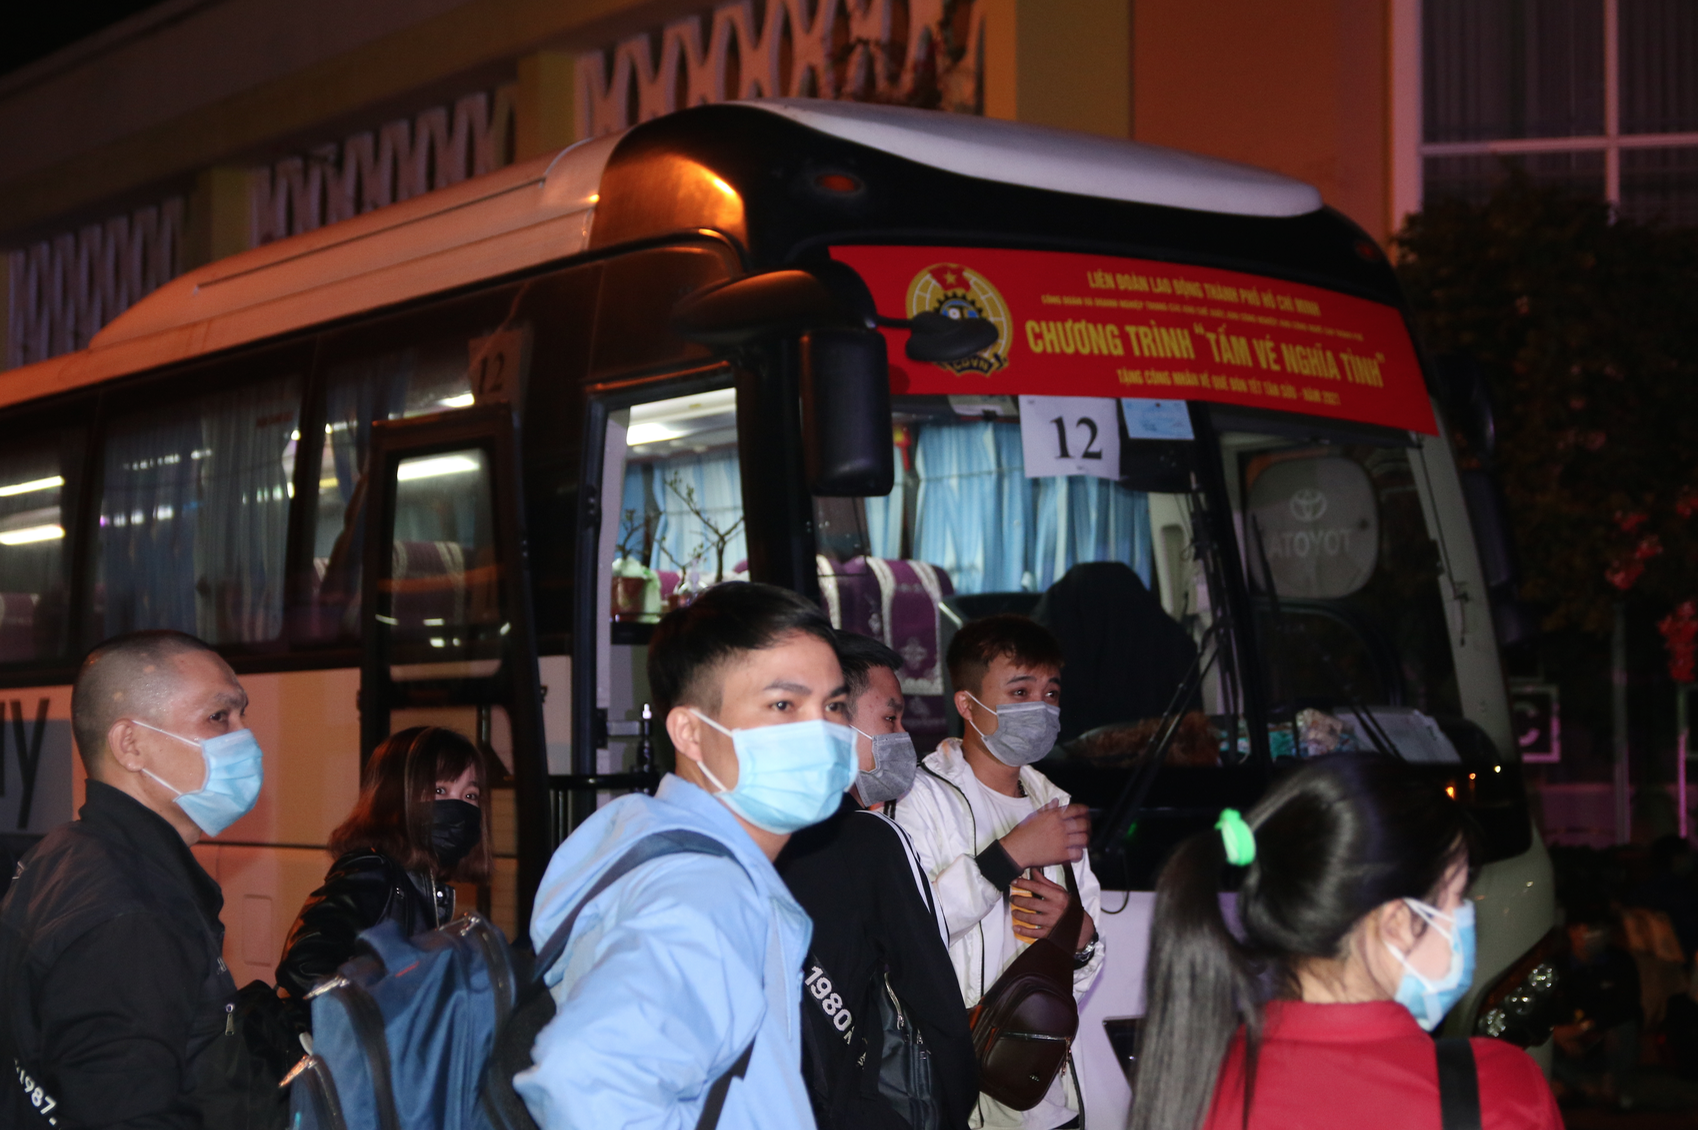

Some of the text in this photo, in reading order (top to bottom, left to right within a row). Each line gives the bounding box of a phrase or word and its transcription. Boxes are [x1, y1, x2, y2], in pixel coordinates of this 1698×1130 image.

[1087, 269, 1115, 290] LIÊN
[1149, 278, 1172, 293] LAO
[1025, 318, 1124, 356] CHƯƠNG
[1124, 319, 1196, 360] TRÌNH
[1252, 333, 1281, 371] VÉ
[1280, 342, 1341, 381] NGHĨA
[477, 352, 505, 395] 12
[1050, 416, 1103, 459] 12
